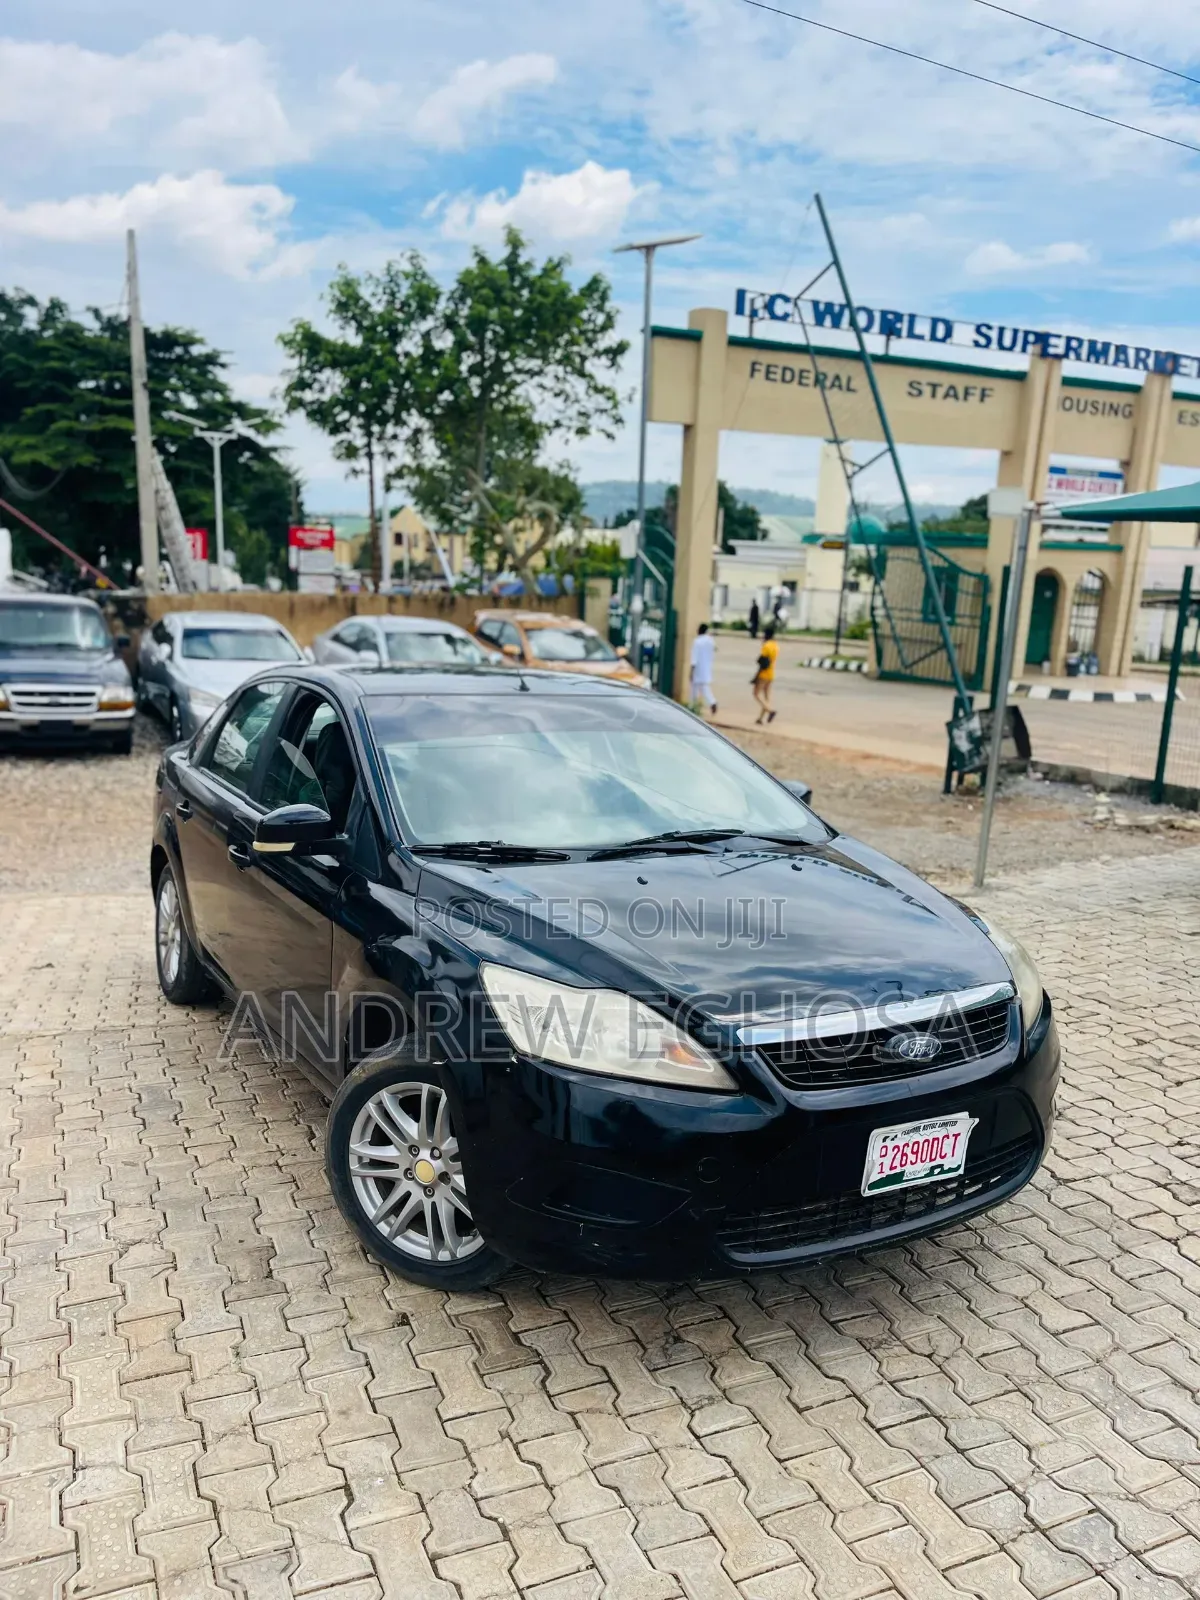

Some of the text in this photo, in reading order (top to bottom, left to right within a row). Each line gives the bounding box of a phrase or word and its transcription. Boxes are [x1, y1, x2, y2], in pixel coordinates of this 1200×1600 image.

[812, 299, 953, 343] WORLD
[749, 361, 859, 393] FEDERAL
[907, 379, 994, 403] STAFF
[1057, 395, 1135, 420] OUSING
[909, 1040, 934, 1057] Ford
[889, 1132, 961, 1170] 2690DCT
